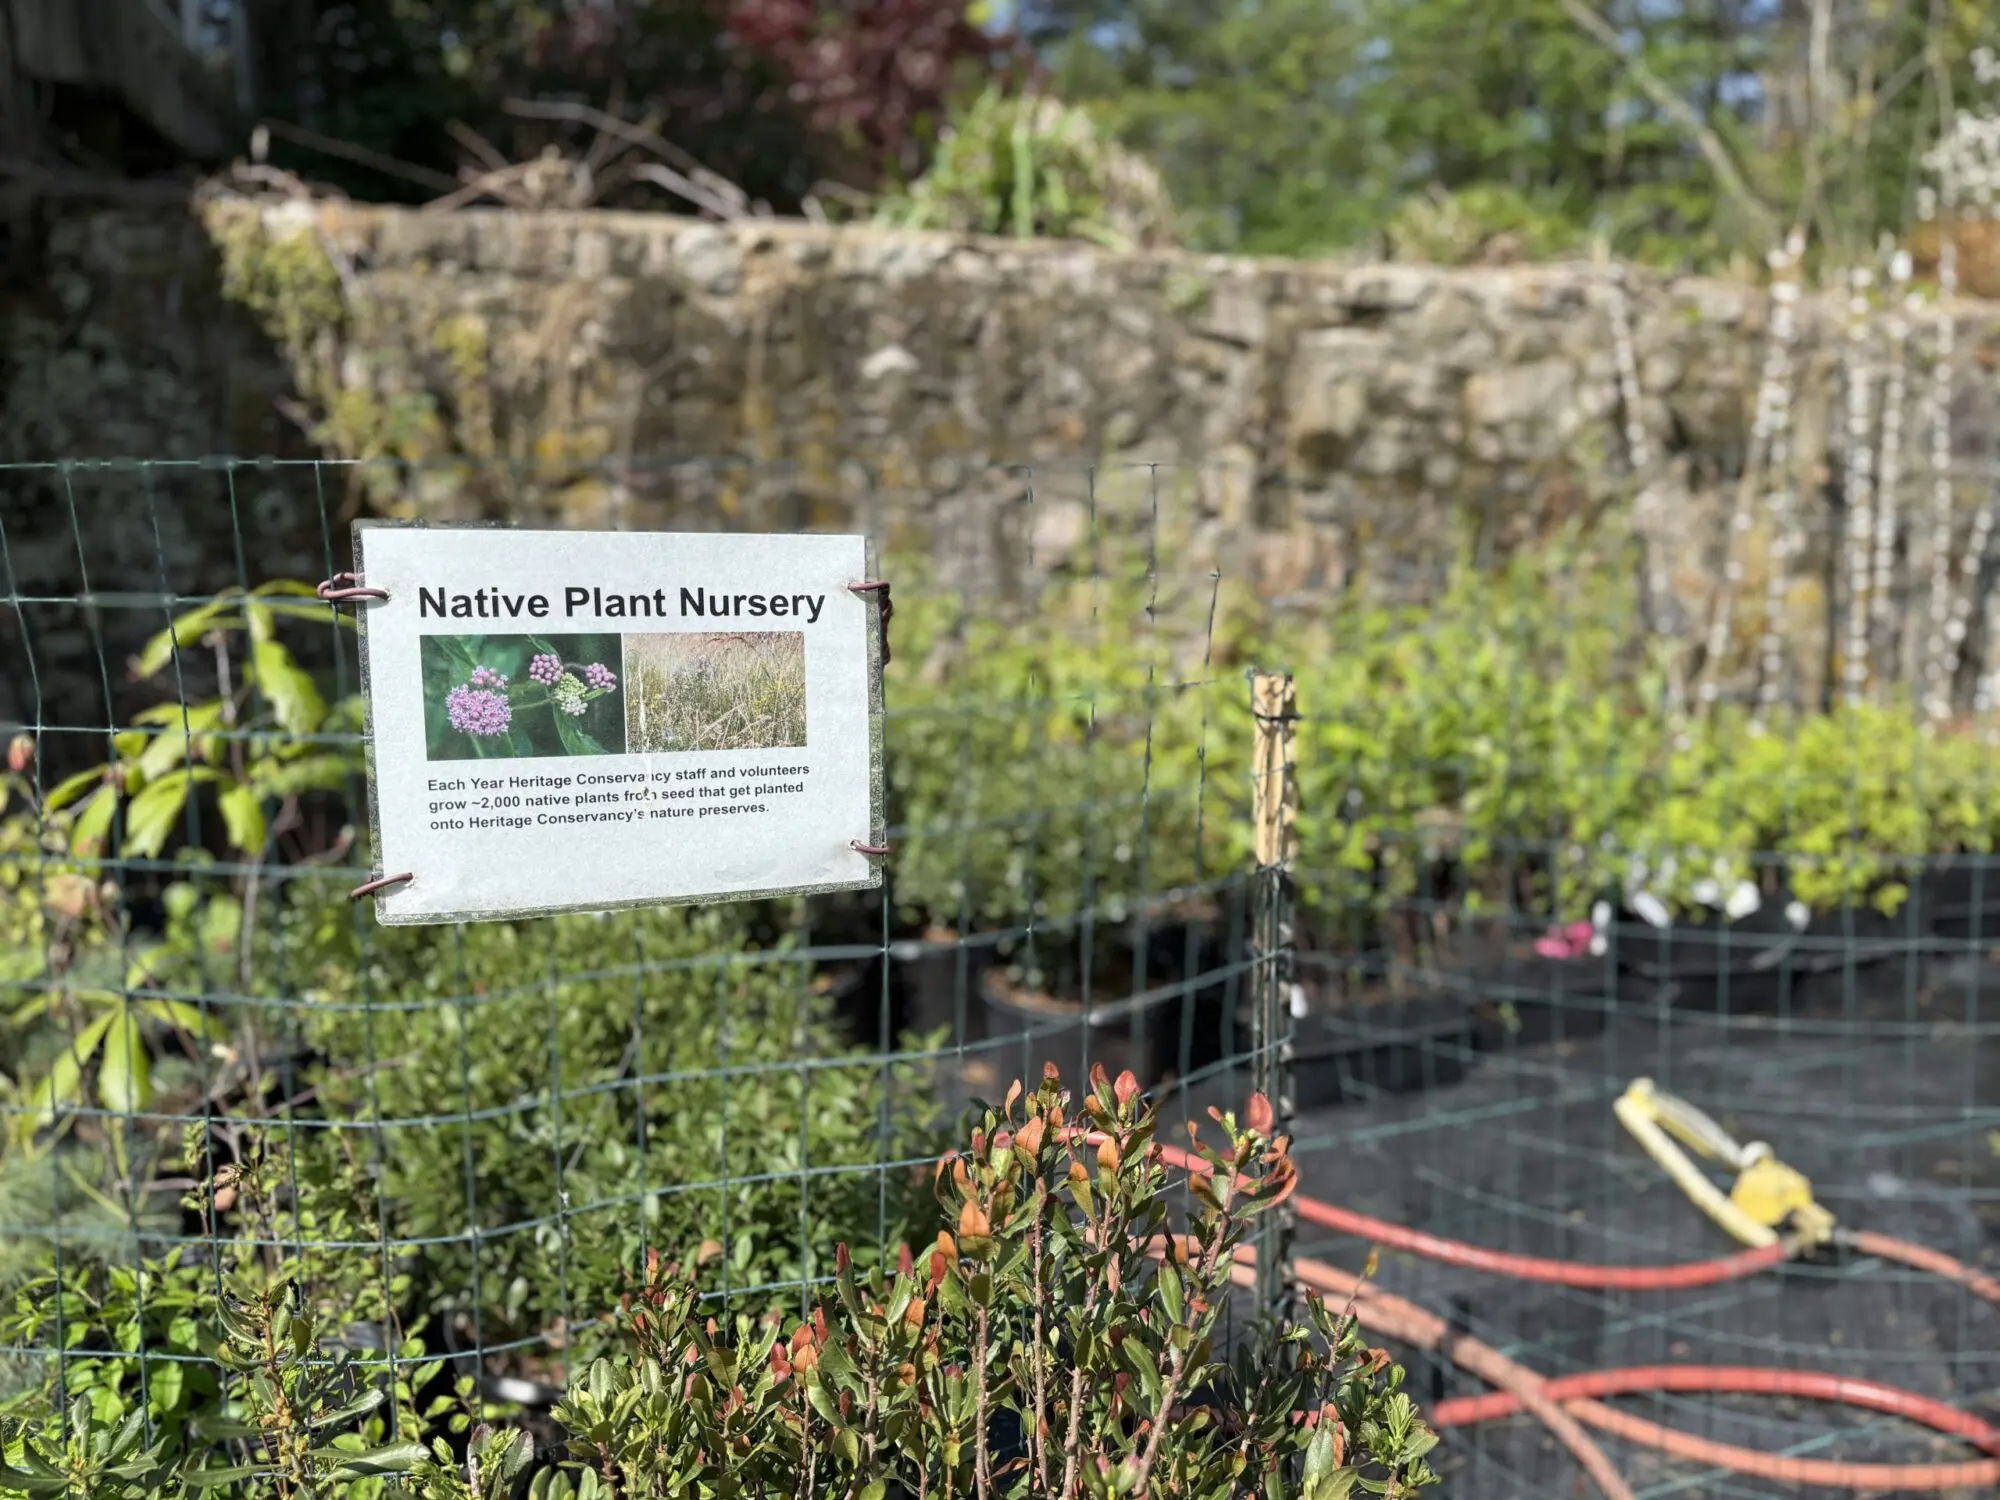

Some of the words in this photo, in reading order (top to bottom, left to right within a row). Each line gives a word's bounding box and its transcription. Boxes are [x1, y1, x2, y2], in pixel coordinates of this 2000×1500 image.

[419, 586, 549, 618] Native
[565, 586, 666, 618] Plant
[680, 586, 826, 623] Nursery
[428, 779, 465, 791] Each
[471, 778, 504, 789] Year
[509, 775, 572, 789] Heritage
[675, 768, 706, 780] staff
[710, 767, 735, 779] and
[739, 764, 810, 778] volunteers
[429, 800, 467, 813] grow
[471, 796, 520, 811] ~2,000
[525, 793, 570, 806] native
[575, 790, 619, 806] plants
[662, 787, 694, 799] seed
[699, 786, 725, 797] that
[729, 784, 750, 799] get
[755, 782, 804, 797] planted
[430, 818, 464, 830] onto
[469, 814, 532, 829] Heritage
[650, 806, 694, 818] nature
[699, 804, 770, 818] preserves.
